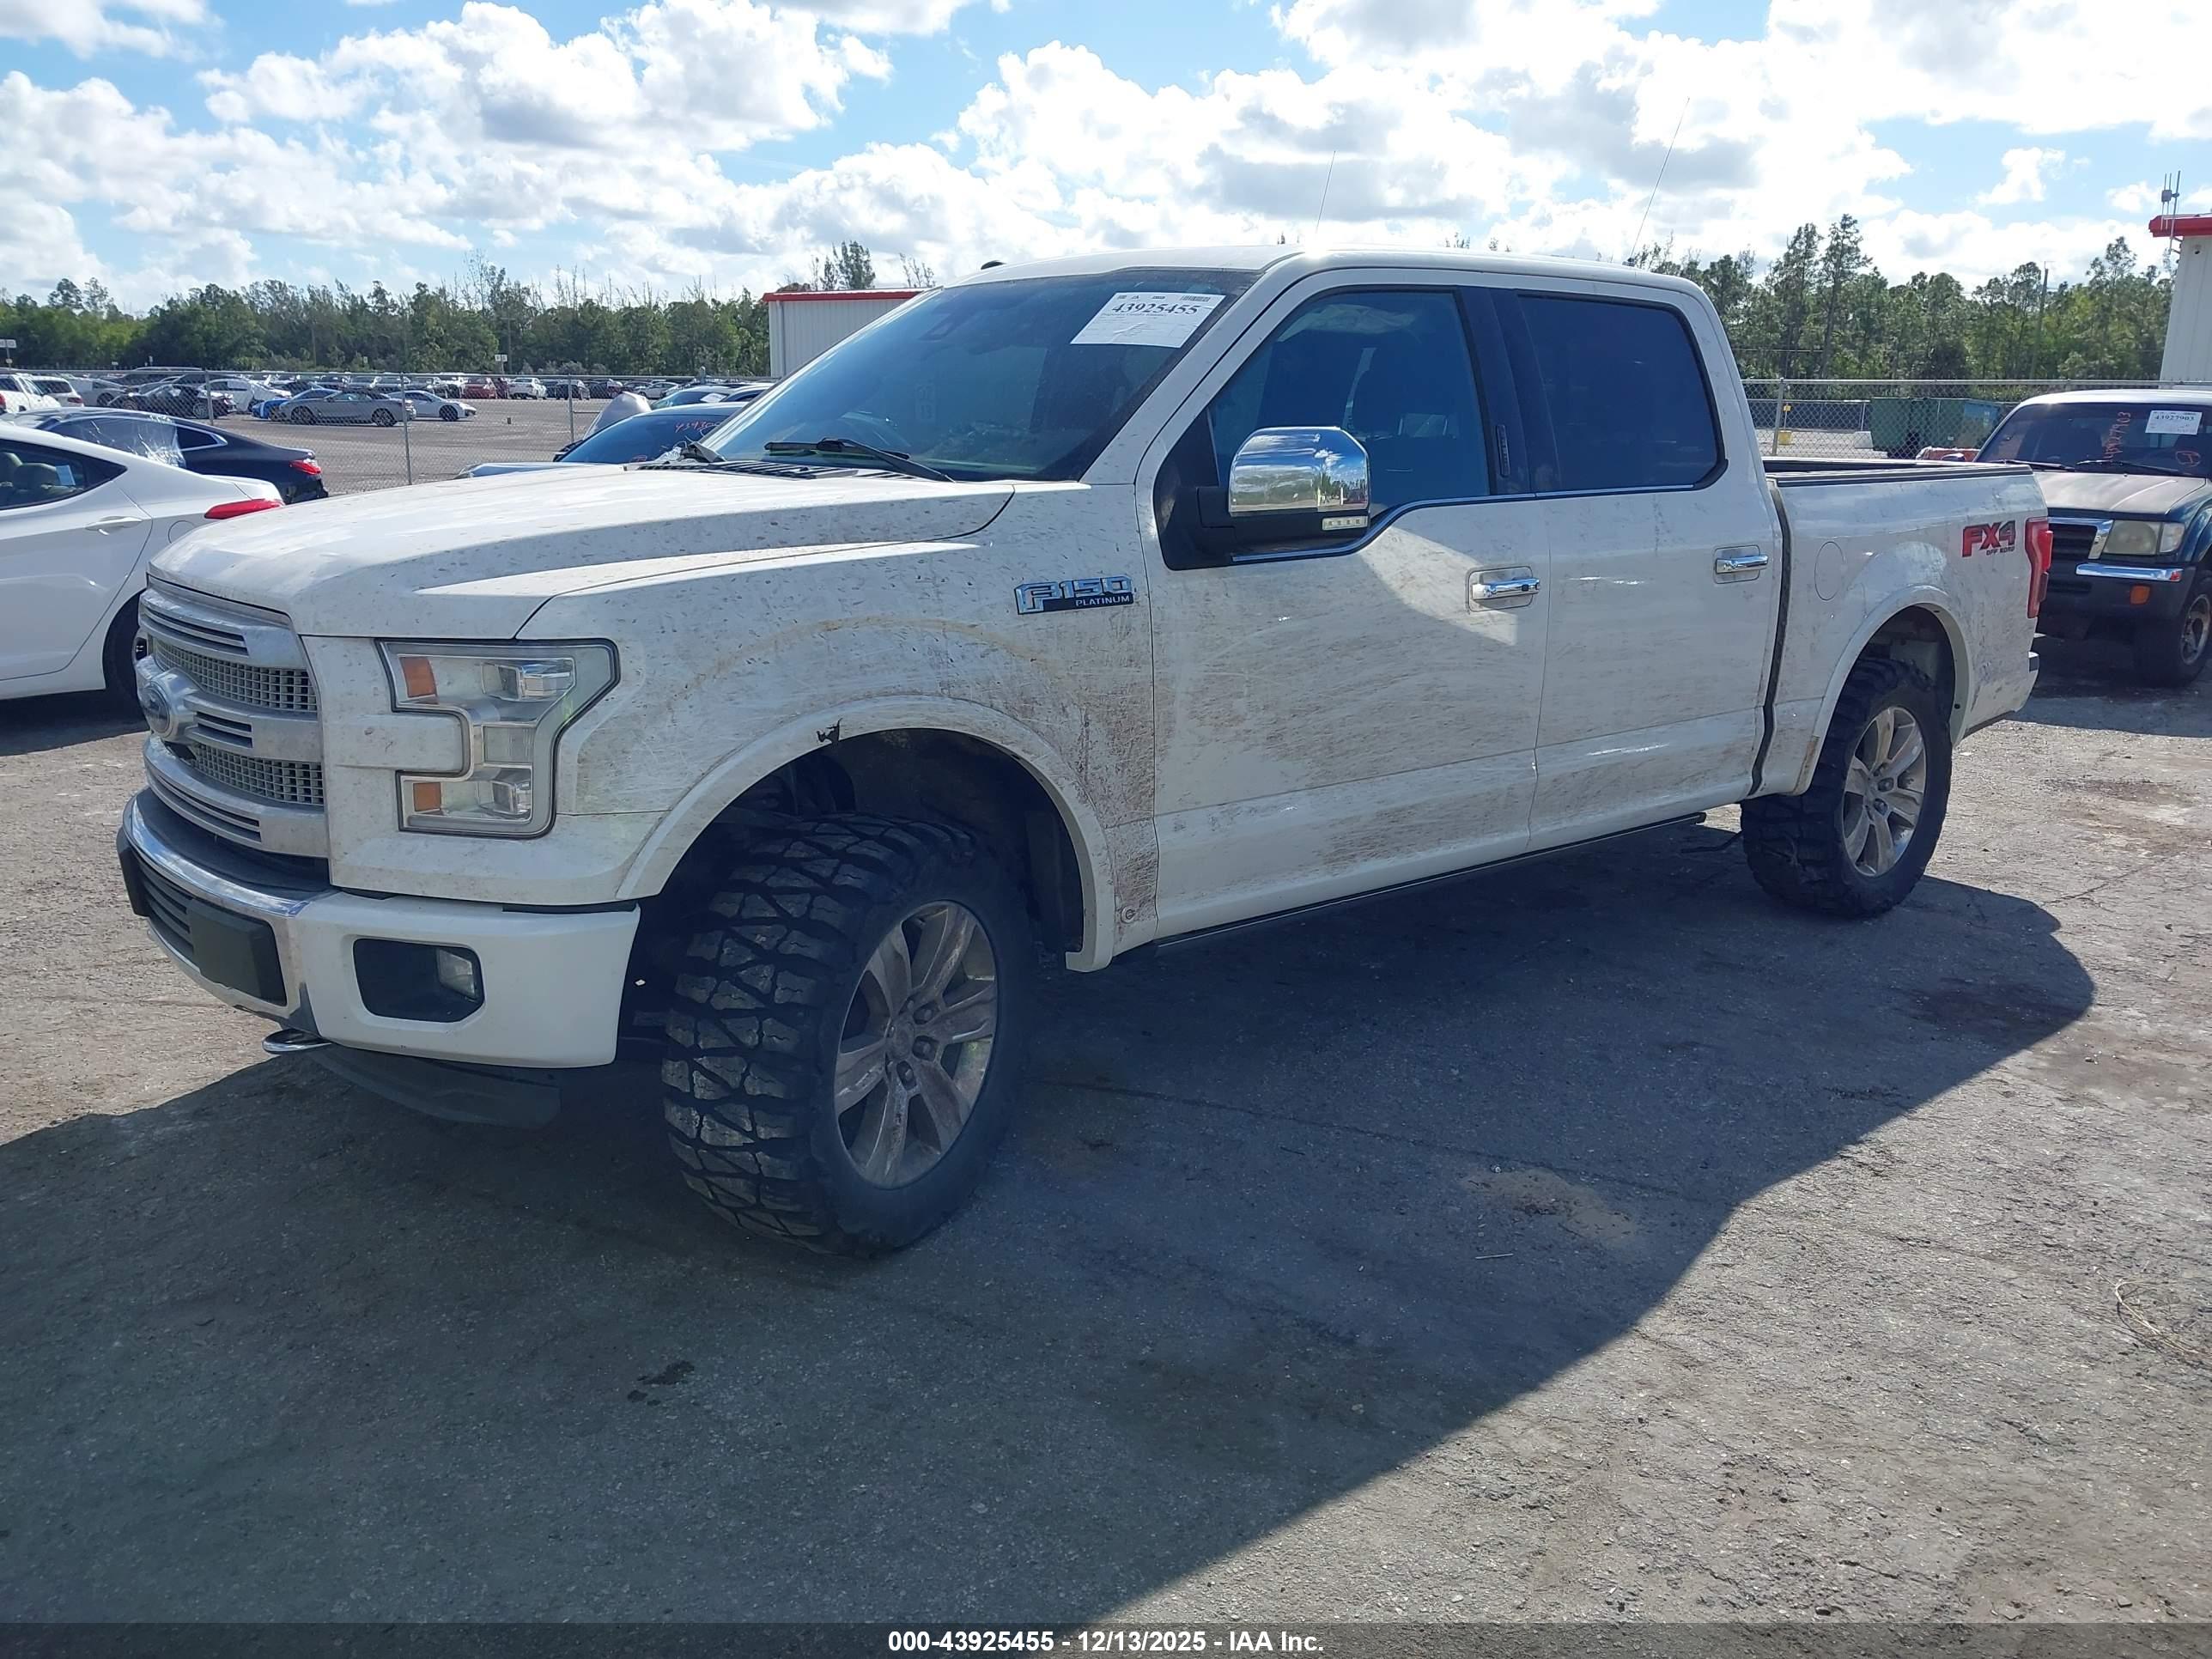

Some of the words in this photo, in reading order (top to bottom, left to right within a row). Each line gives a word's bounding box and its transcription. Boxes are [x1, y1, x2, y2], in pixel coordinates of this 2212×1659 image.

[1112, 302, 1200, 314] 43925455
[1962, 520, 2016, 557] FX4
[1075, 596, 1130, 606] PLATINUM
